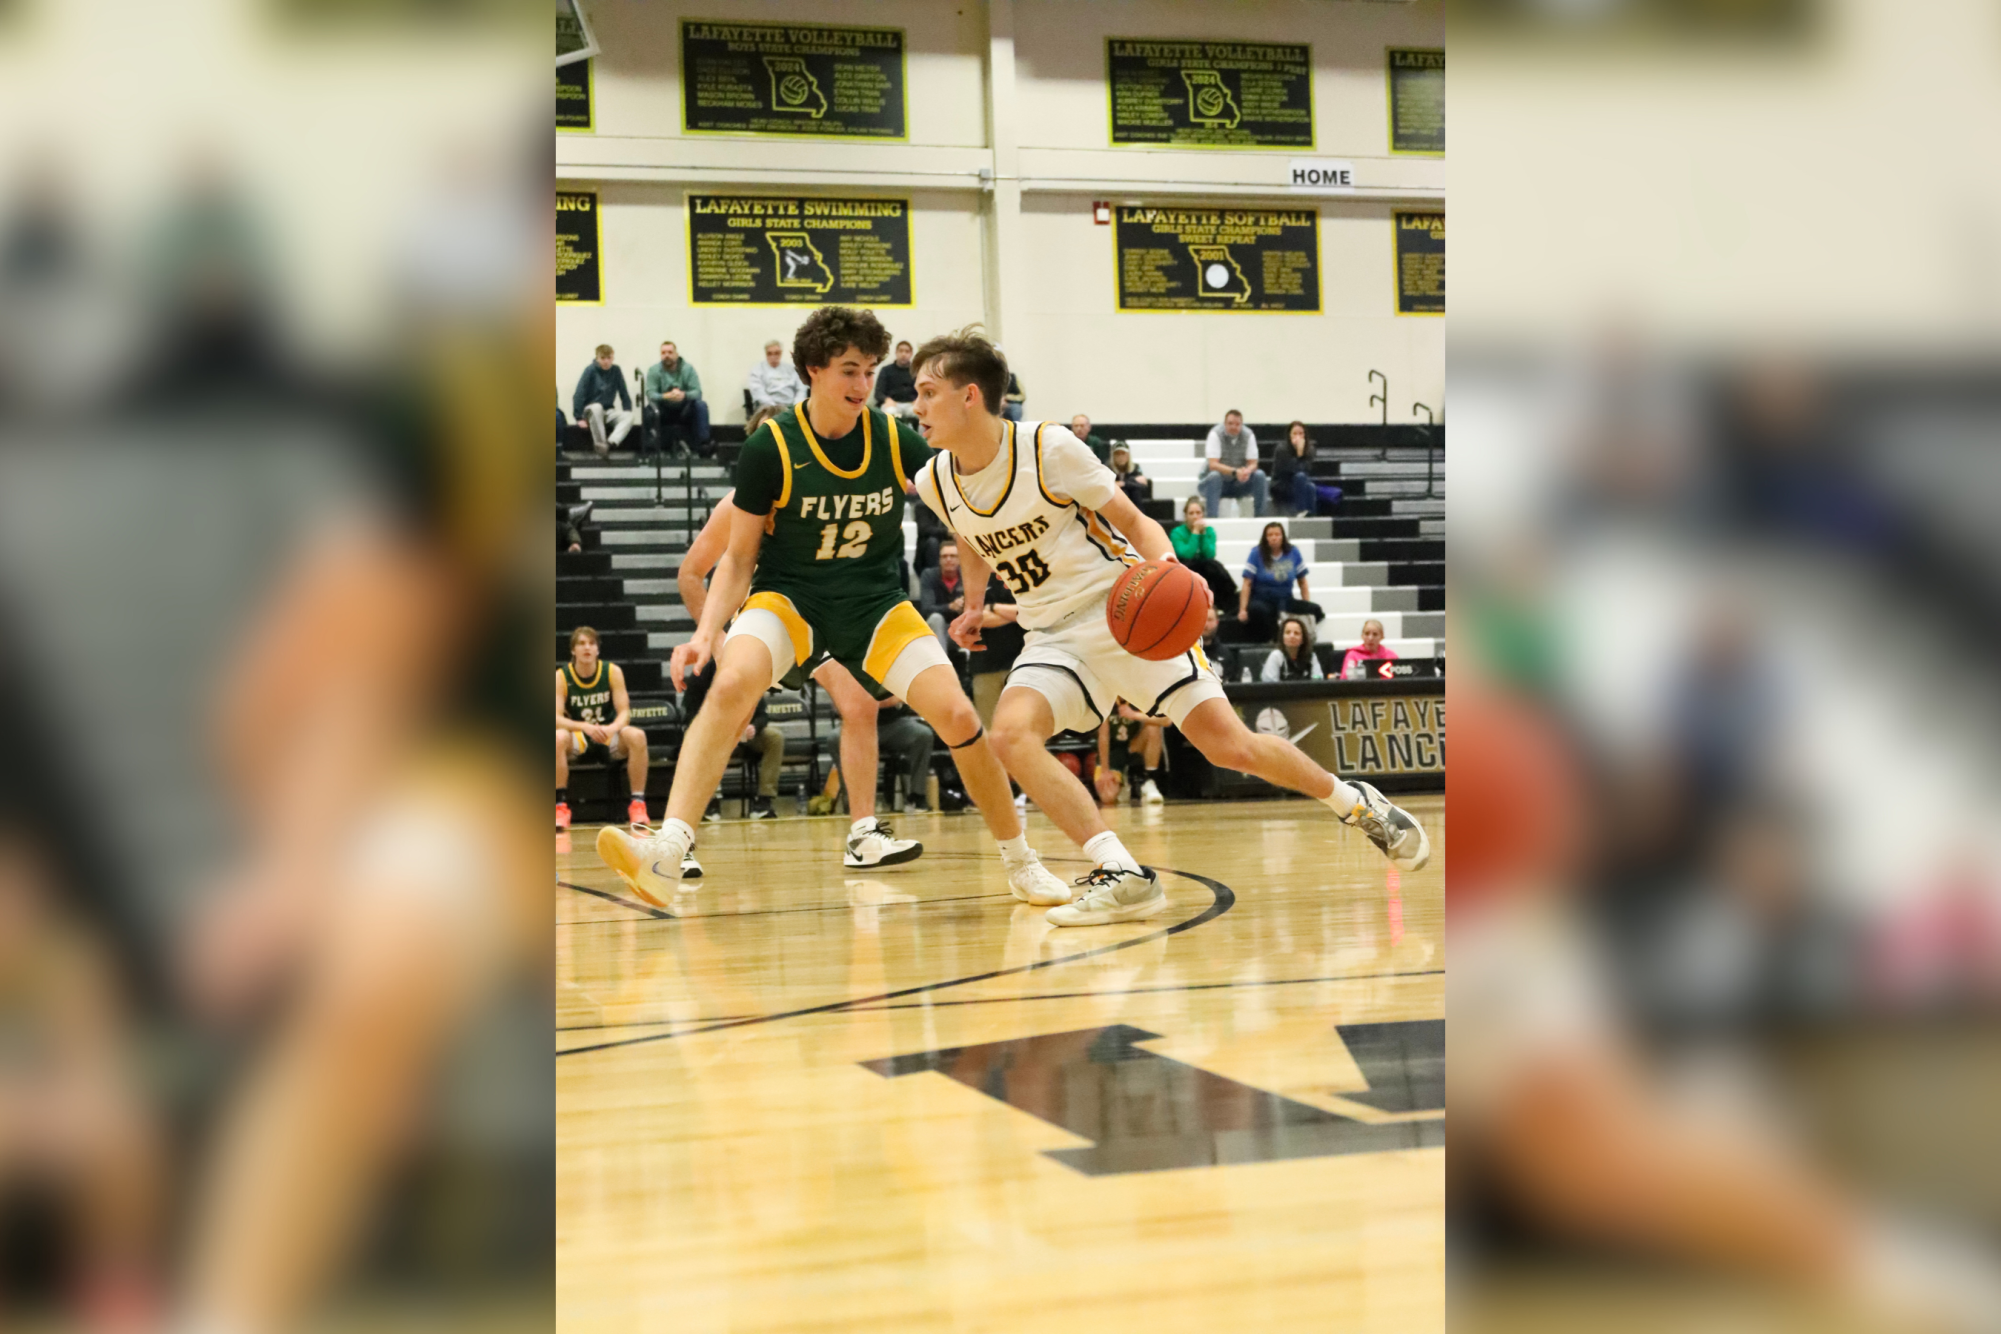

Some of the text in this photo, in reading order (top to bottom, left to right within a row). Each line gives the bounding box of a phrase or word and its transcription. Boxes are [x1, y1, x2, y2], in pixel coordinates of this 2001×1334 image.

[688, 25, 897, 47] LAFAYETTE VOLLEYBALL
[758, 43, 791, 53] STATE
[794, 45, 860, 56] CHAMPIONS
[1113, 43, 1304, 61] LAFAYETTE VOLLEYBALL
[774, 62, 800, 72] 2024
[1181, 59, 1210, 68] STATE
[1213, 60, 1273, 70] CHAMPIONS
[1192, 75, 1215, 84] 2024
[1292, 169, 1351, 185] HOME
[556, 196, 591, 211] ING
[695, 198, 902, 217] LAFAYETTE SWIMMING
[727, 218, 872, 230] GIRLS STATE CHAMPIONS
[1122, 209, 1311, 227] LAFAYETTE SOFTBALL
[1401, 216, 1445, 230] LAFA
[1152, 225, 1282, 235] GIRLS STATE CHAMPIONS
[1179, 234, 1257, 244] SWEET REPEAT
[1199, 250, 1224, 260] 2001
[800, 486, 893, 520] FLYERS
[815, 520, 873, 560] 12
[996, 548, 1051, 594] 30
[1390, 665, 1413, 675] POSS
[571, 692, 610, 707] FLYERS
[581, 706, 606, 724] 21
[765, 703, 802, 714] FAYETTE
